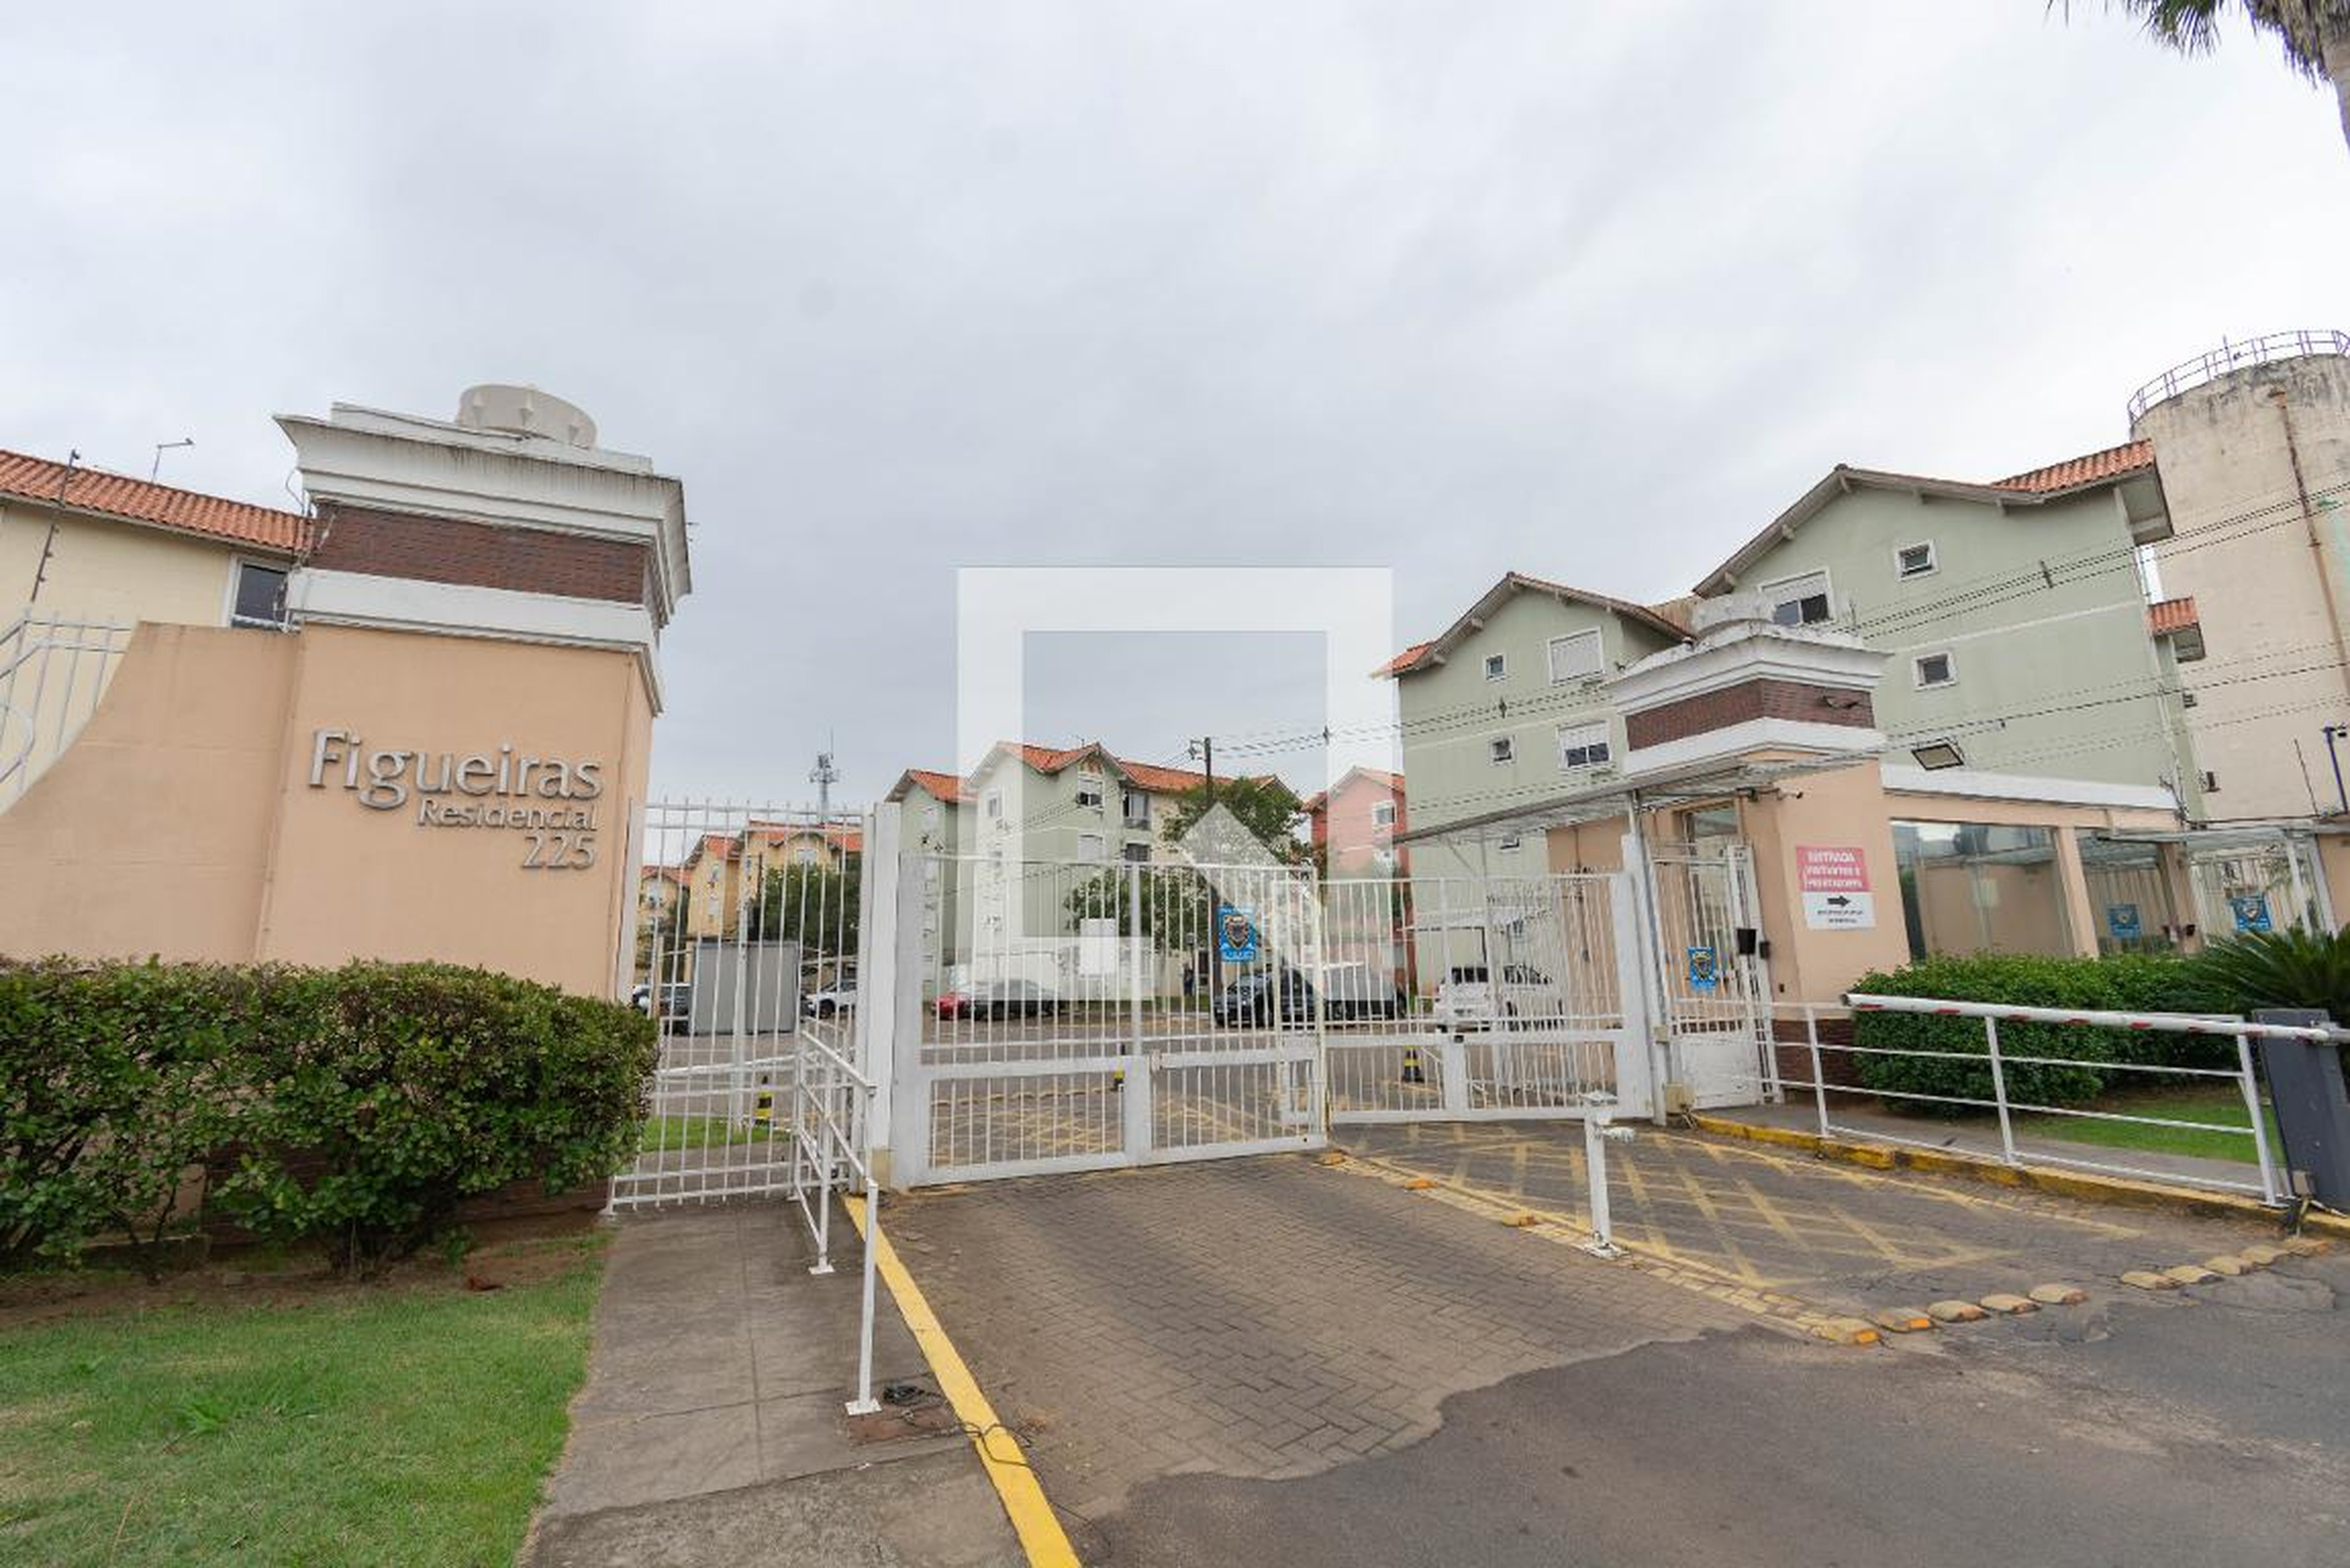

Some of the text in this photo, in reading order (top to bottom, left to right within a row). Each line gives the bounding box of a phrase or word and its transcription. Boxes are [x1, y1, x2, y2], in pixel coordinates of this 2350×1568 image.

[307, 727, 603, 810] Figueiras
[417, 797, 598, 831] Residencial
[521, 834, 597, 869] 225
